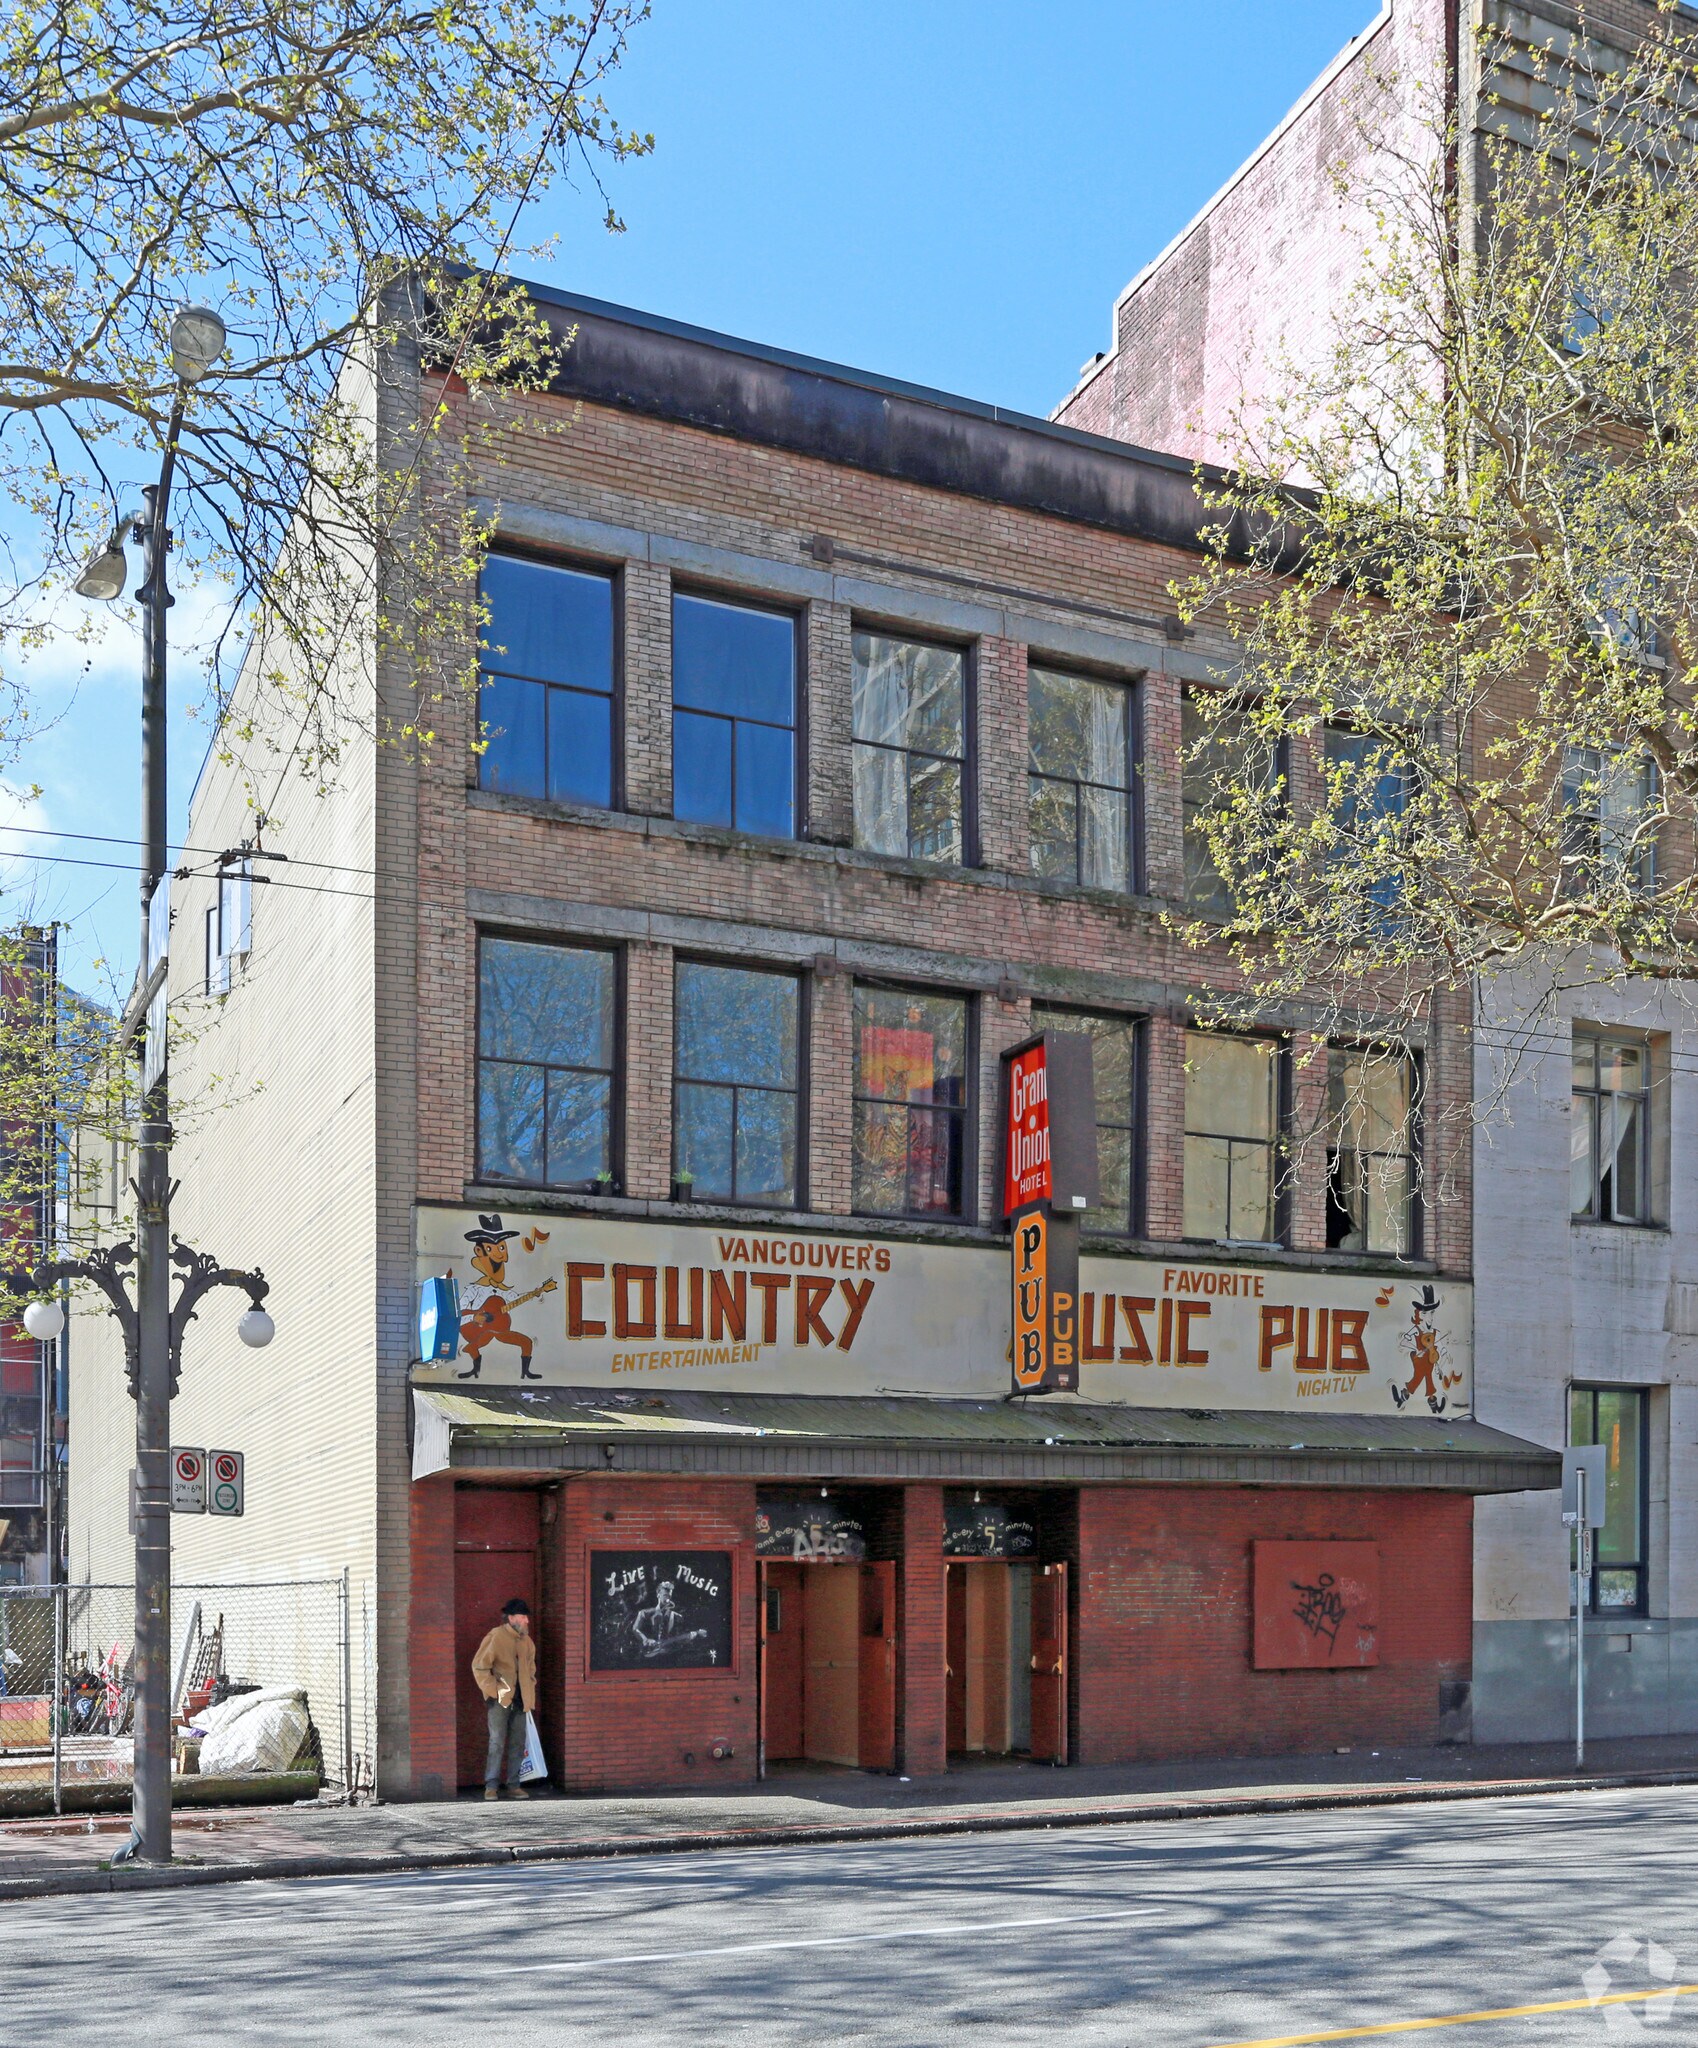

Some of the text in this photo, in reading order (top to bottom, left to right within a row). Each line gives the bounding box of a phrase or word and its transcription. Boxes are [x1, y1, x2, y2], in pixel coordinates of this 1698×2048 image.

[1011, 1126, 1050, 1182] Union
[1019, 1171, 1047, 1194] HOTEL
[718, 1236, 891, 1272] VANCOUVER'S
[565, 1261, 875, 1352] COUNTRY
[1018, 1223, 1043, 1375] PUB
[1163, 1269, 1264, 1298] FAVORITE
[1052, 1291, 1074, 1366] PUB
[1080, 1291, 1370, 1374] USIC PUB
[611, 1342, 762, 1373] ENTERTAINMENT
[1296, 1375, 1357, 1399] NIGHTLY
